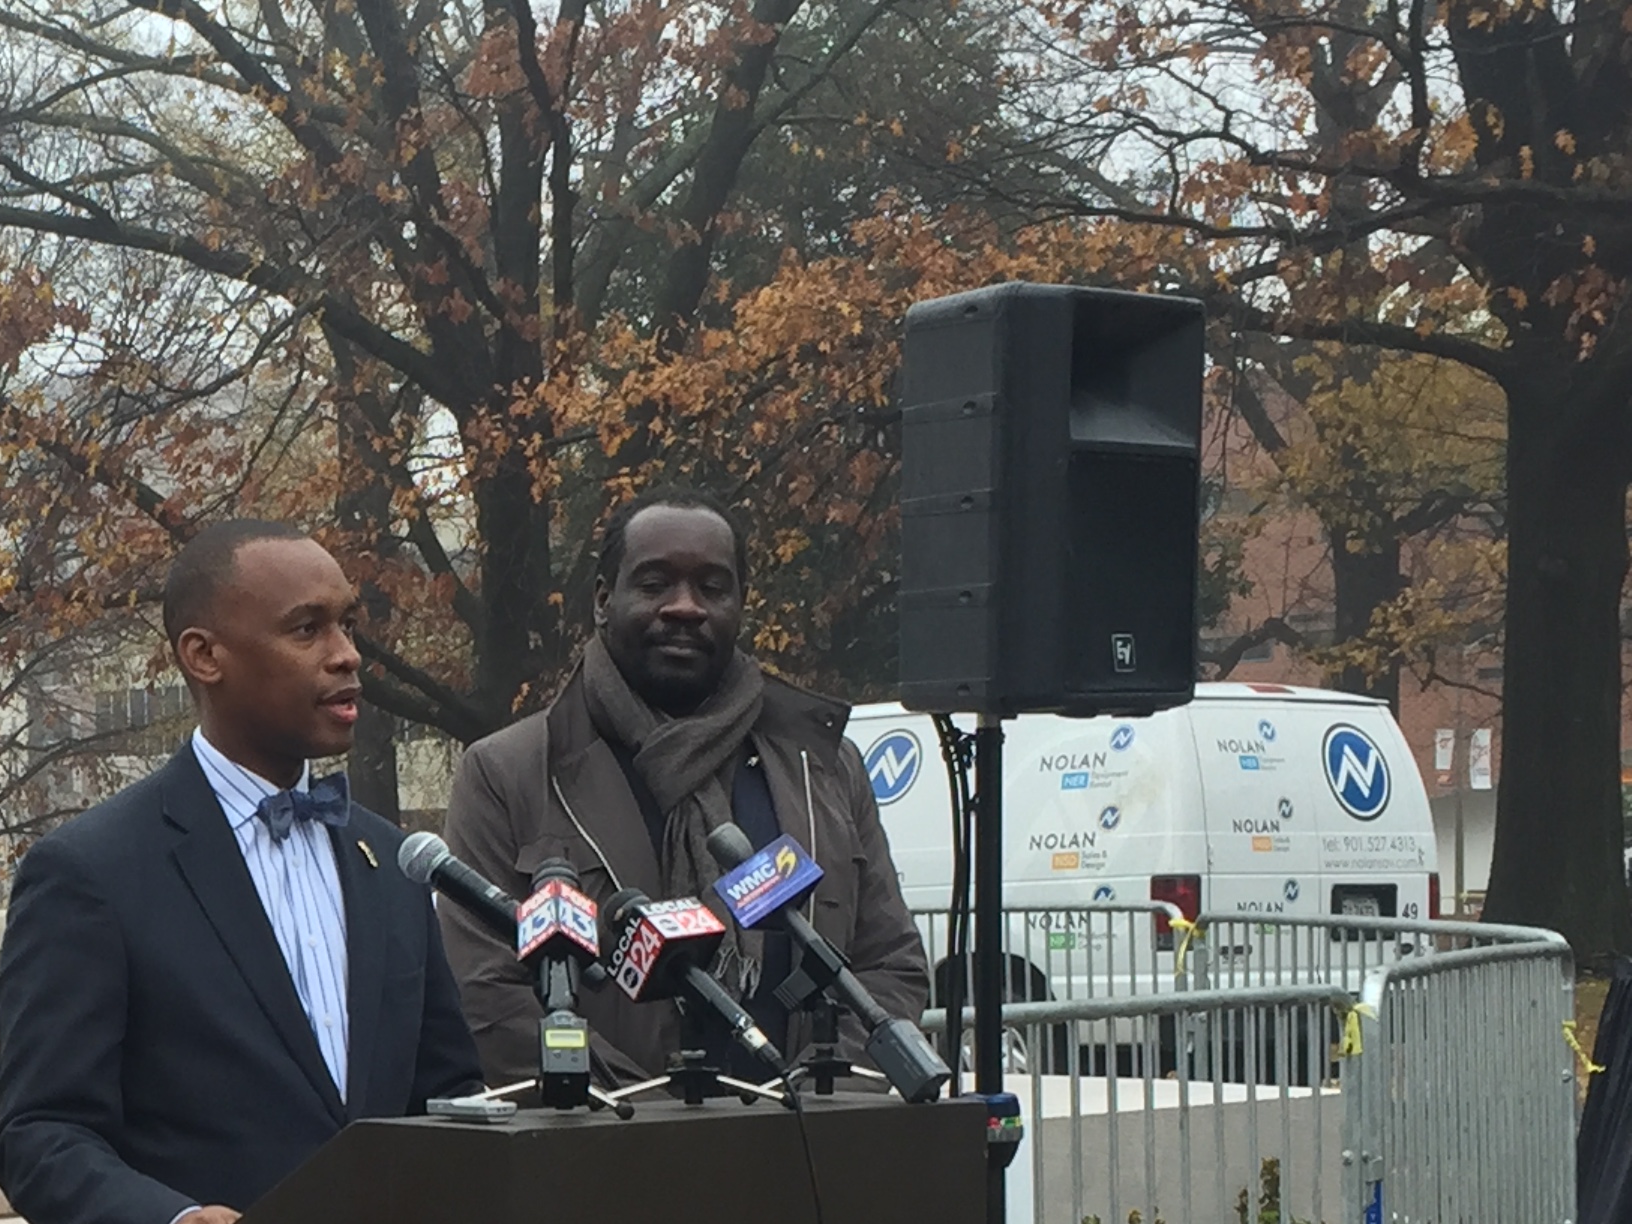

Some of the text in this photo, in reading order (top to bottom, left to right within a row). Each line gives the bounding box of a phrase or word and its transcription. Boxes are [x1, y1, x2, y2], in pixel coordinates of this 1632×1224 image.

[1216, 739, 1266, 755] NOLAN
[1039, 752, 1107, 772] NOLAN
[1232, 819, 1280, 833] NOLAN
[1029, 831, 1096, 851] NOLAN
[1343, 836, 1416, 853] 901.527.4313
[727, 863, 777, 901] WMC
[774, 845, 797, 879] 5
[521, 882, 551, 918] FOX
[637, 897, 702, 915] LOCAL
[674, 907, 726, 934] 24
[1402, 902, 1418, 919] 49
[519, 898, 556, 949] 13
[607, 916, 641, 977] LOCAL
[630, 925, 662, 973] 24
